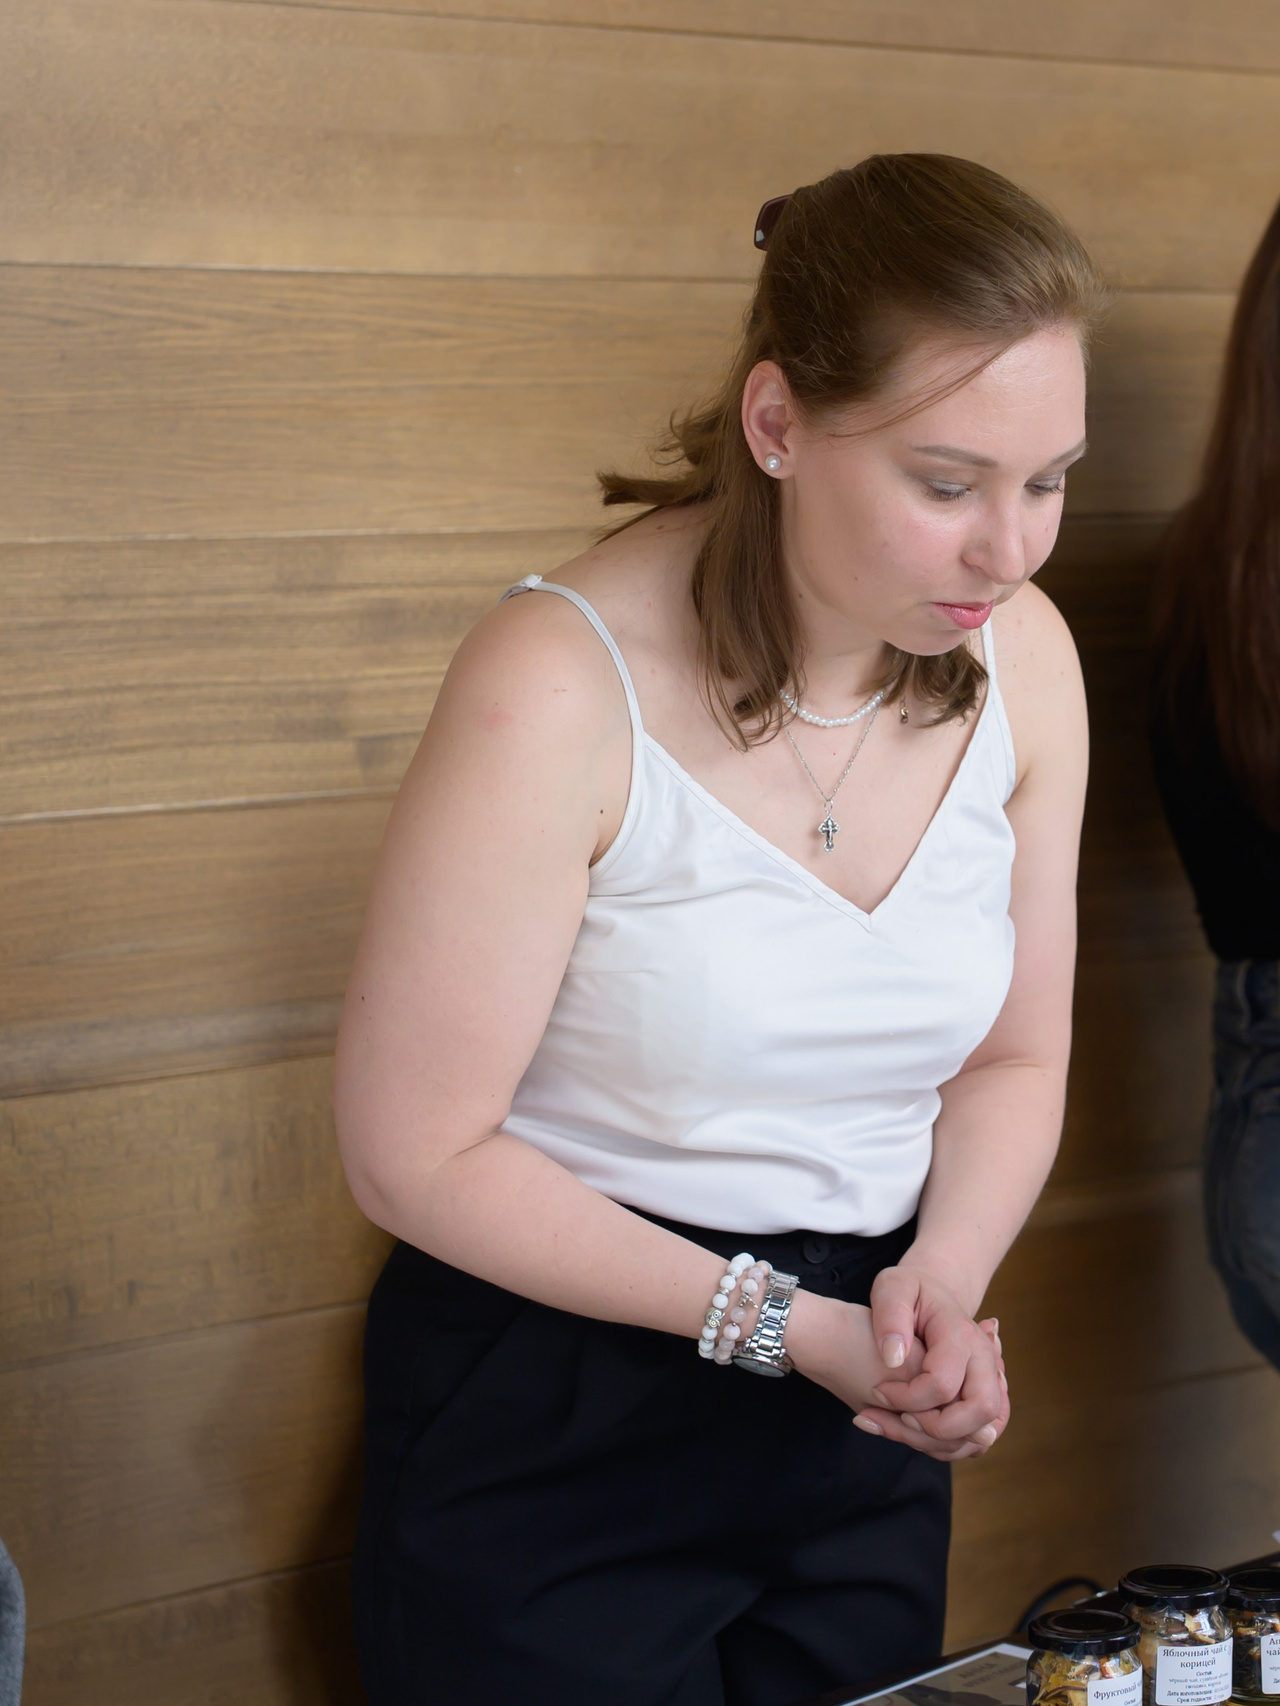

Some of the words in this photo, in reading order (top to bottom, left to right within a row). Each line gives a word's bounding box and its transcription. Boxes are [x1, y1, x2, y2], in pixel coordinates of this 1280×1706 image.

[1163, 1648, 1209, 1657] Яблочный
[1210, 1645, 1223, 1654] чай
[1180, 1657, 1216, 1669] корицей
[1094, 1682, 1136, 1700] Фруктовый
